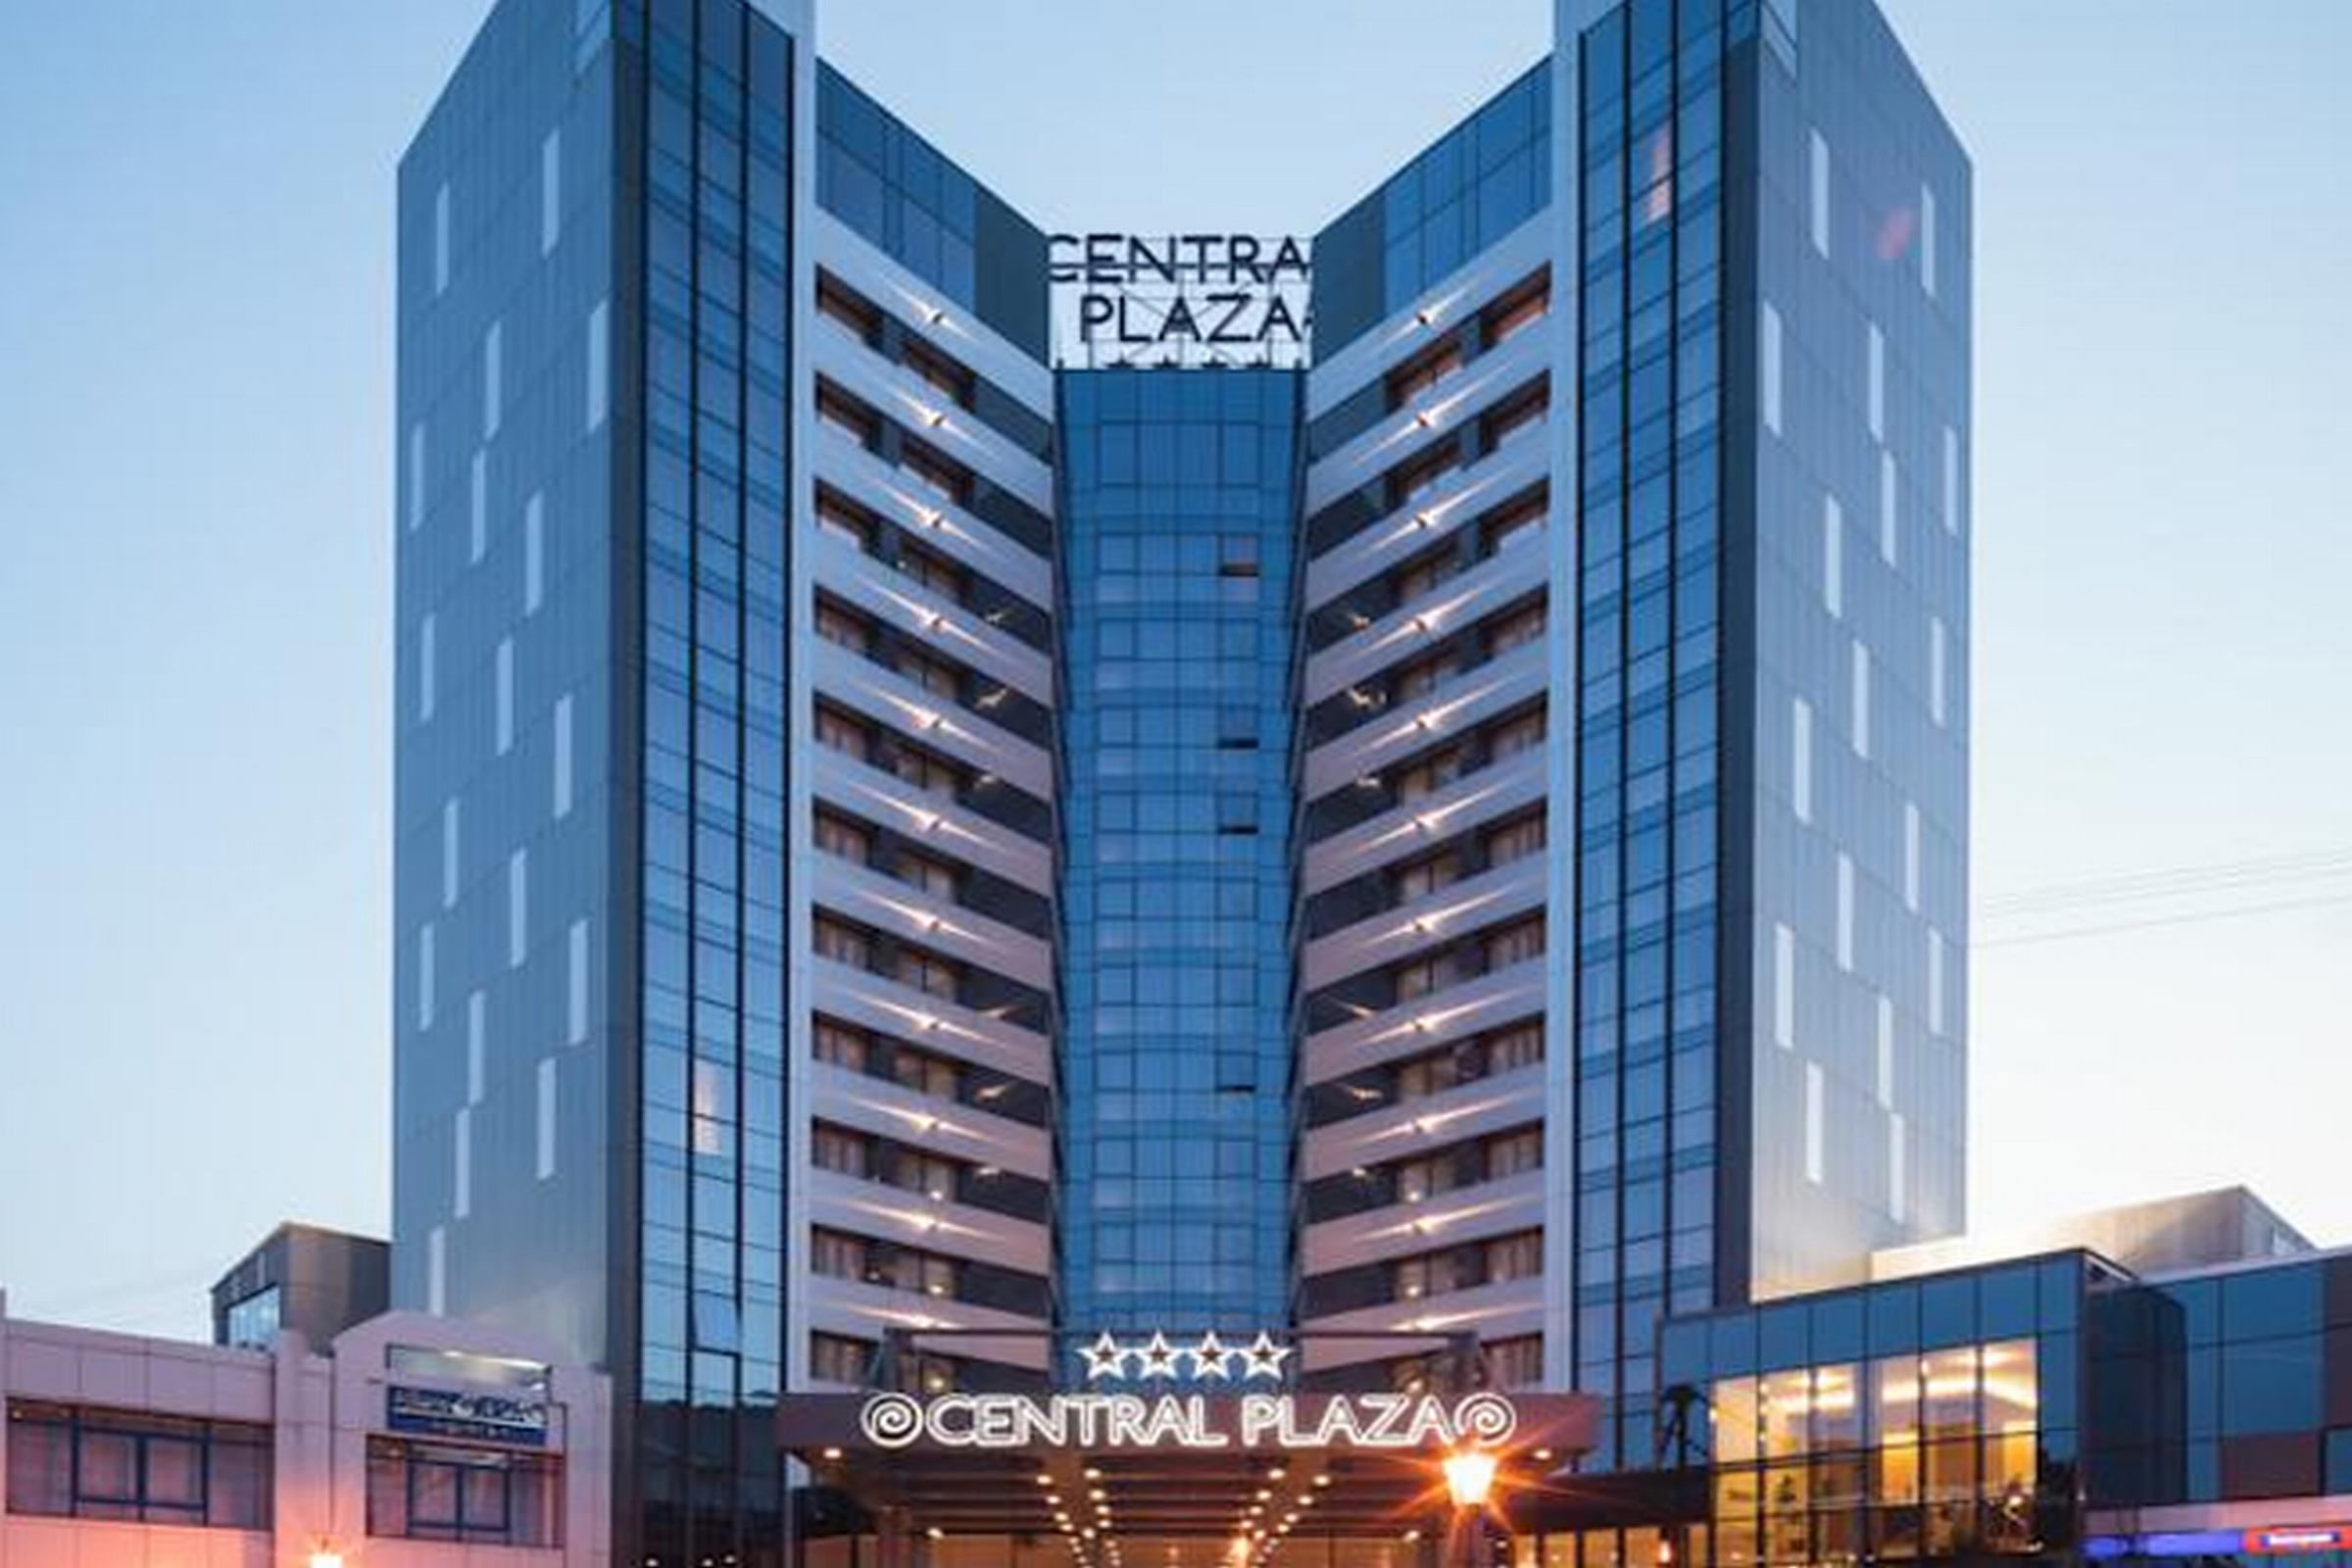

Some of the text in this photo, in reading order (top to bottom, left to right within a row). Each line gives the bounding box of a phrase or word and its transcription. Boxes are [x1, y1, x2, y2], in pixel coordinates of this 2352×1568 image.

[1048, 234, 1309, 283] CENTRA
[1081, 295, 1302, 342] PLAZA
[926, 1393, 1454, 1447] CENTRAL PLAZA
